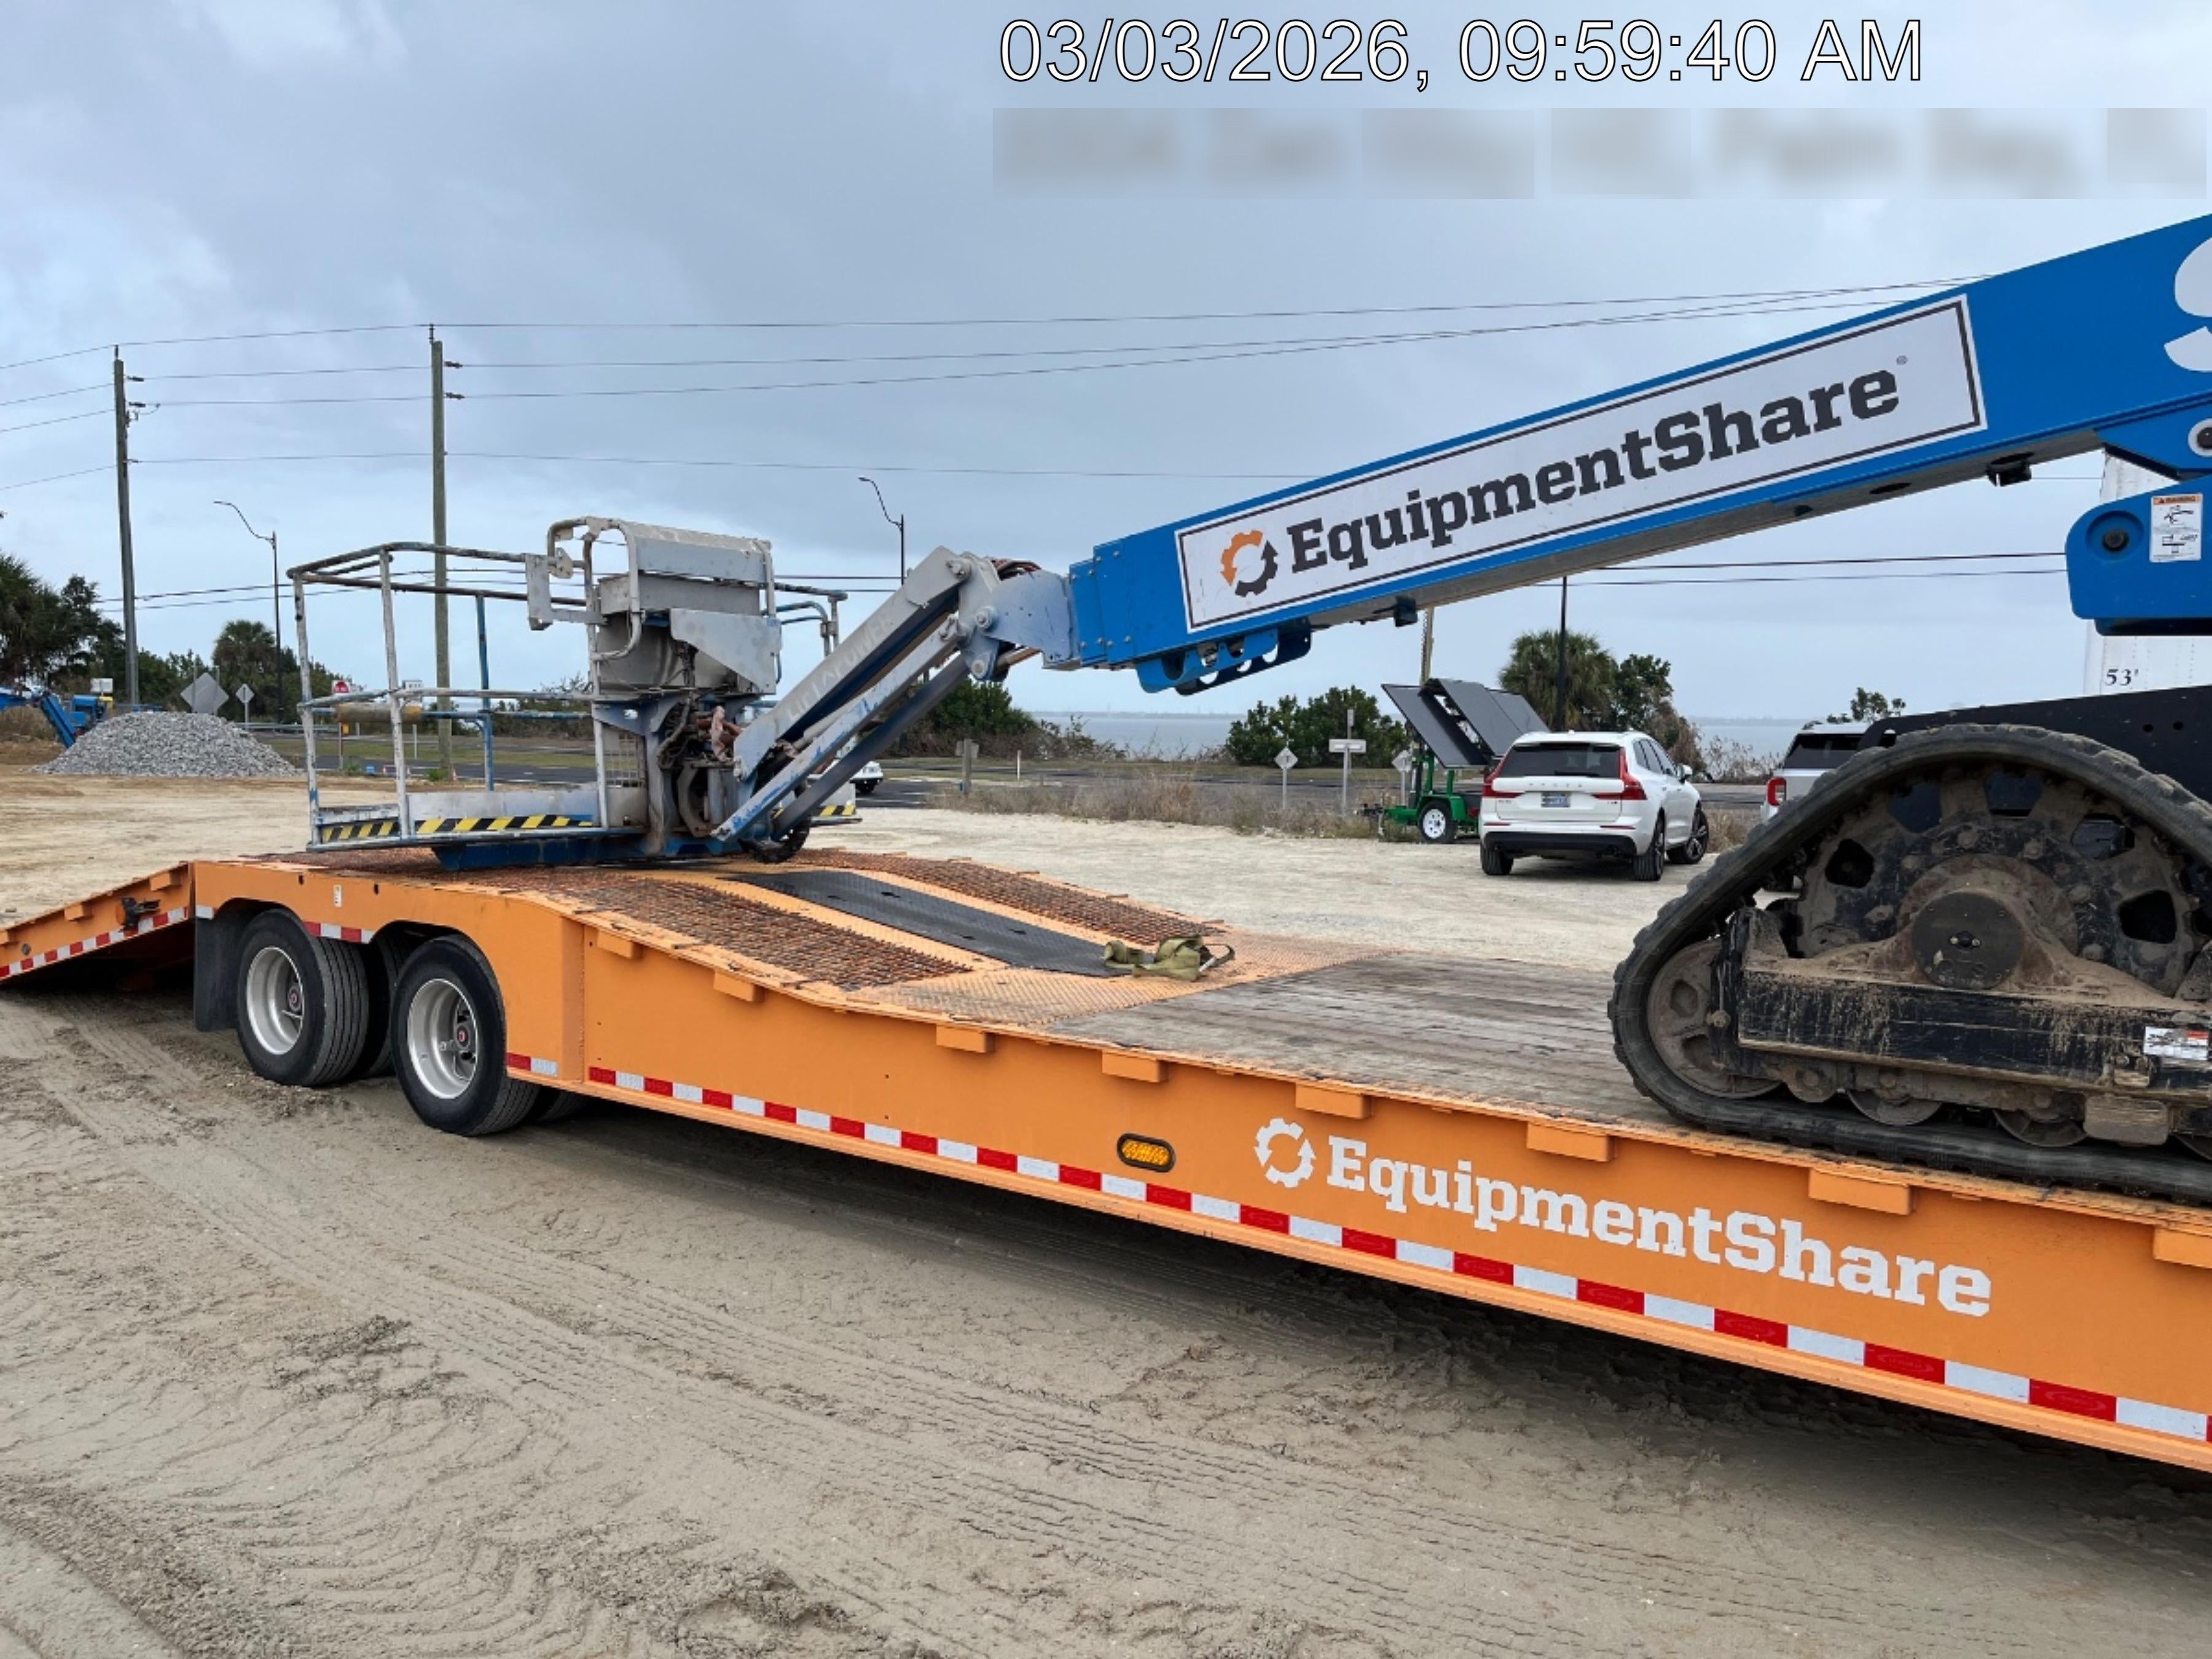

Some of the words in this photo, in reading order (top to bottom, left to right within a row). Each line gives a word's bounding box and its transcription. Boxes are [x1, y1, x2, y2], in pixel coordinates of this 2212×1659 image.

[1287, 369, 1900, 574] EquipmentShare
[2104, 668, 2139, 686] 53'
[1327, 1135, 1992, 1317] EquipmentShare
